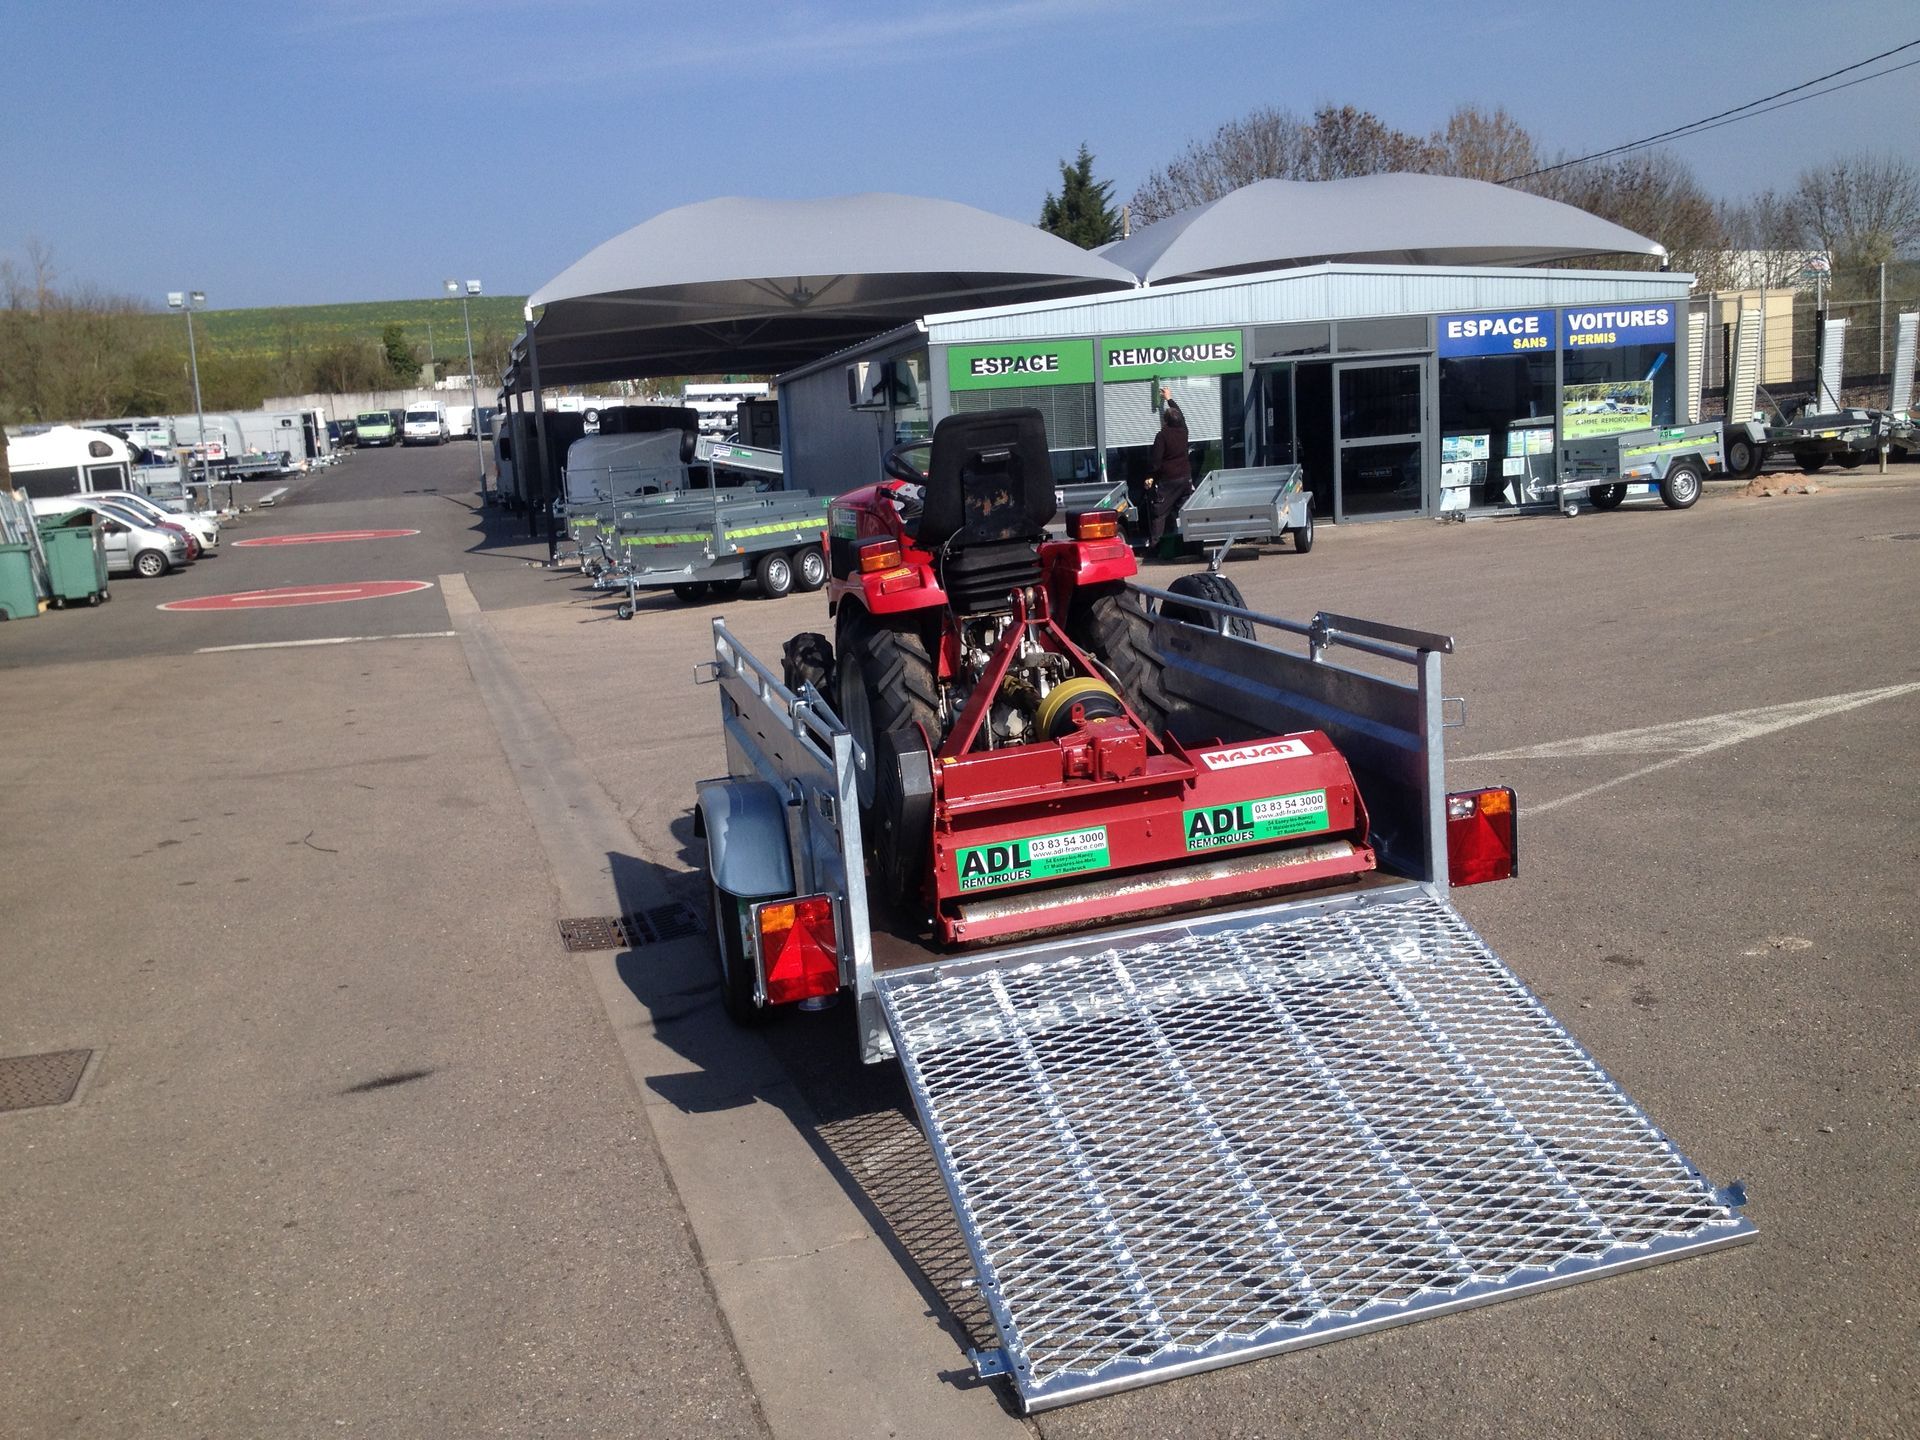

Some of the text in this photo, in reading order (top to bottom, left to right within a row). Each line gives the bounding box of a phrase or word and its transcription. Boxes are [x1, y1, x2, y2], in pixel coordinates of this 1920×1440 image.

[1448, 308, 1669, 338] ESPACE VOITURES
[1513, 332, 1616, 349] SANS PERMIS
[970, 342, 1237, 376] ESPACE REMORQUES
[1207, 744, 1294, 764] MAJAR
[1255, 794, 1323, 813] 03 83 54 3000
[1256, 804, 1324, 820] www.adl-france.com
[1188, 806, 1254, 838] ADL
[1032, 832, 1104, 852] 03 83 54 3000
[1033, 841, 1105, 858] www.adl-france.com
[1189, 831, 1255, 849] REMORQUES
[961, 844, 1032, 878] ADL
[962, 869, 1031, 888] REMORQUES
